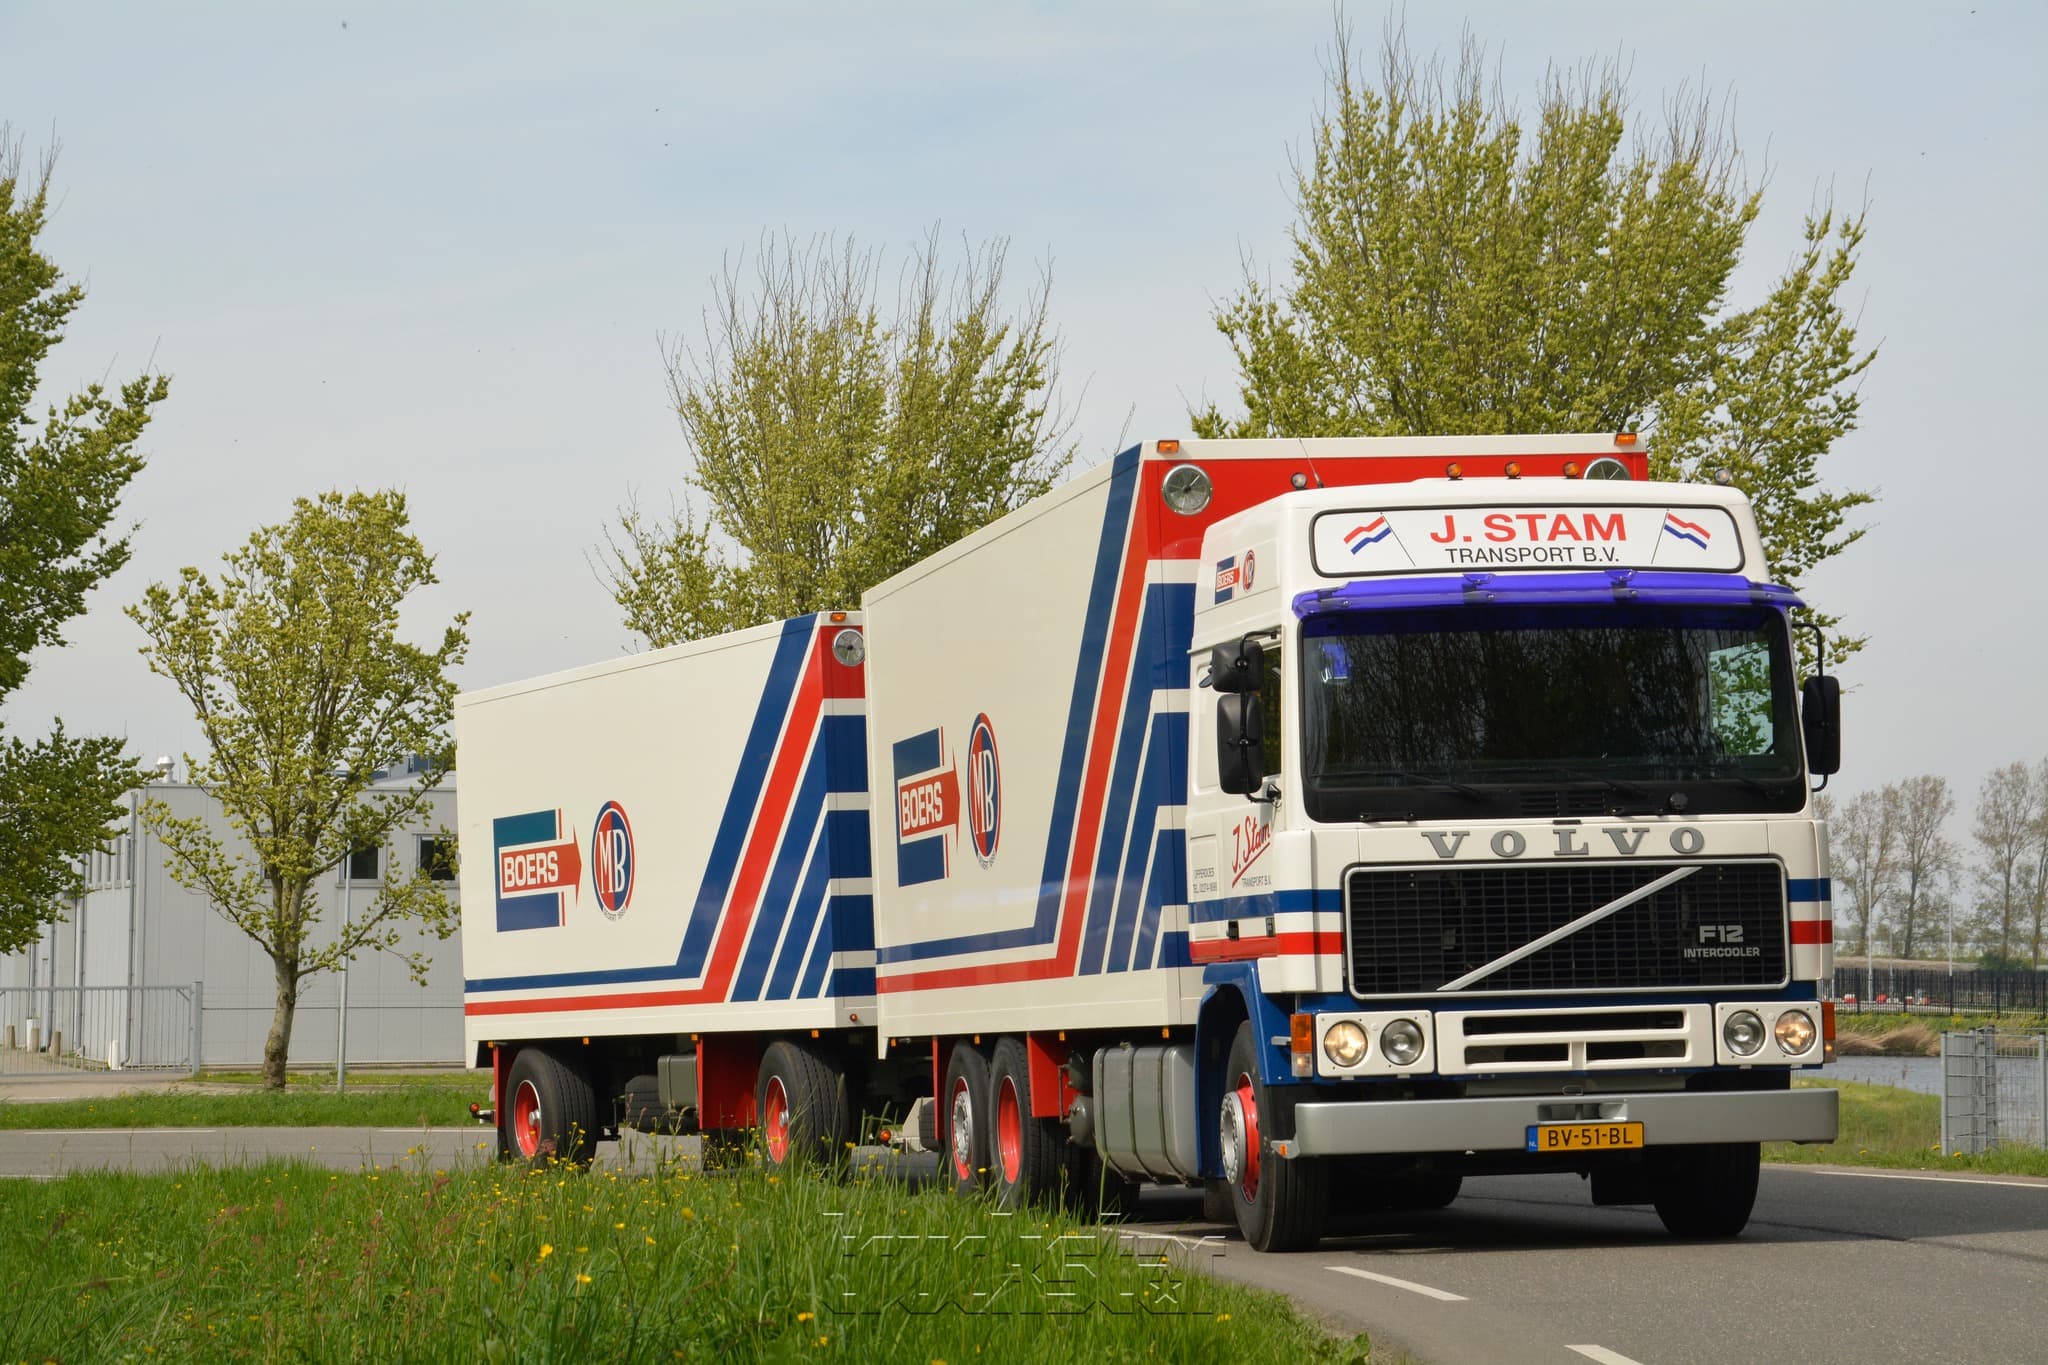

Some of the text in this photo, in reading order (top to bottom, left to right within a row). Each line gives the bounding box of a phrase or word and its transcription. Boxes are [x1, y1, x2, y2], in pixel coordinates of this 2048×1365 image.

[1430, 514, 1627, 543] J. STAM
[1445, 547, 1619, 563] TRANSPORT B.V.
[901, 781, 943, 831] BOERS
[972, 749, 995, 835] MB
[1243, 815, 1271, 863] Stam
[1421, 827, 1705, 859] VOLVO
[503, 850, 559, 888] BOERS
[598, 828, 627, 894] MB
[1699, 925, 1744, 943] F12
[1684, 947, 1760, 958] INTERCOOLER
[1548, 1127, 1633, 1147] BV-51-BL
